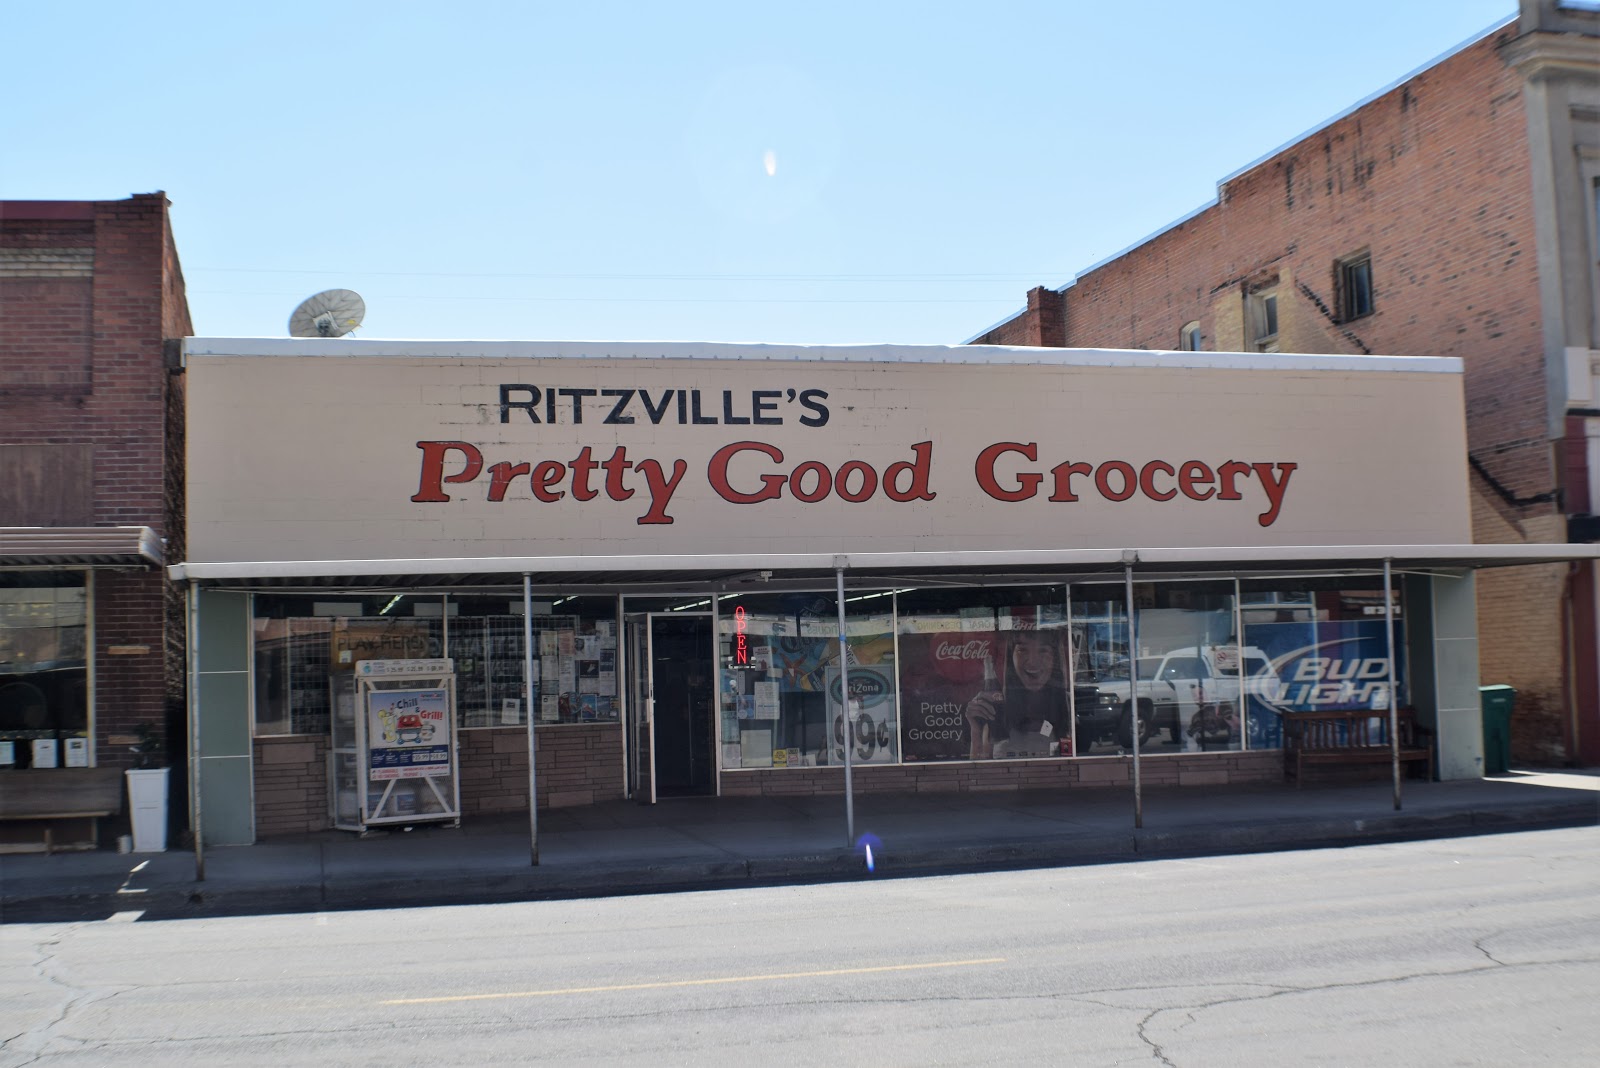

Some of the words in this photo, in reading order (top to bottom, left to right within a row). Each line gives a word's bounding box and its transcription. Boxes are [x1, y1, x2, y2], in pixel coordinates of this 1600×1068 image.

[499, 383, 830, 427] RITZVILLE'S
[410, 440, 687, 525] Pretty
[707, 440, 937, 504] Good
[974, 441, 1298, 527] Grocery
[735, 606, 747, 665] OPEN
[935, 640, 991, 660] Coca-Cola
[1293, 657, 1390, 682] BUD
[396, 698, 418, 710] Chill
[920, 702, 962, 715] Pretty
[420, 710, 443, 721] Grill!
[924, 714, 963, 727] Good
[908, 728, 963, 741] Grocery
